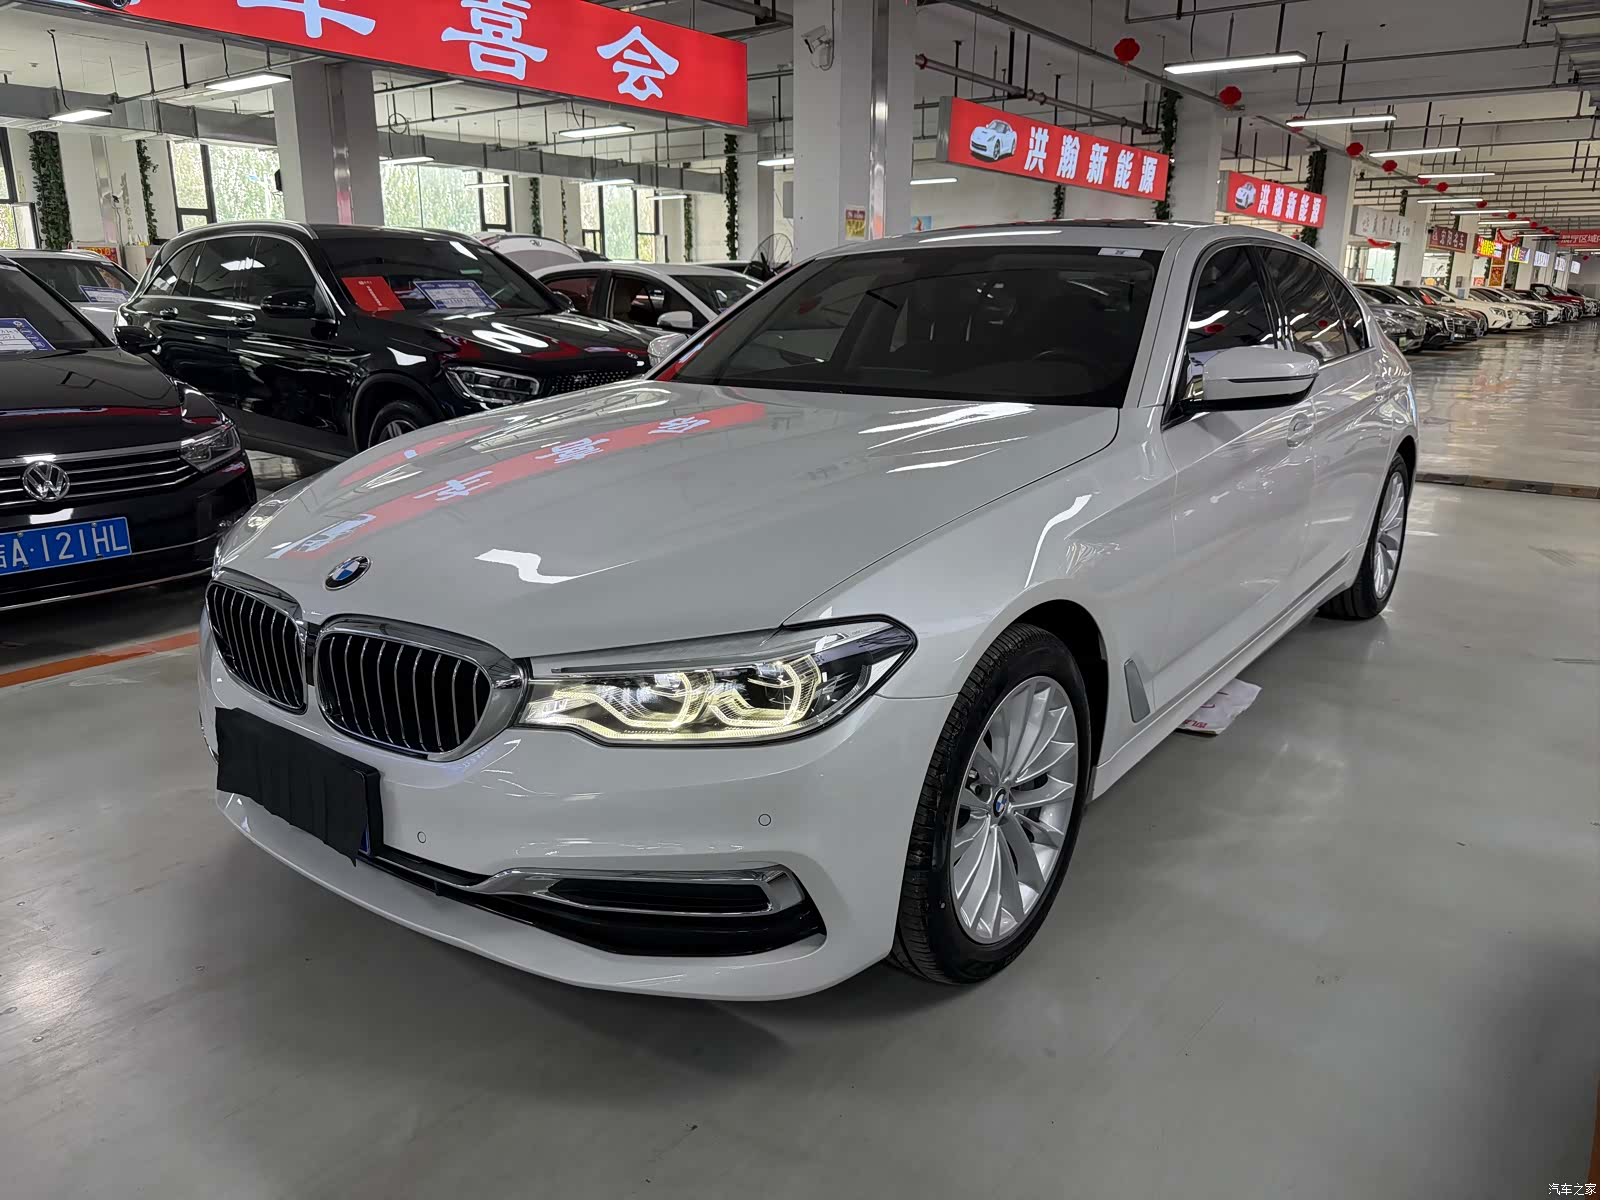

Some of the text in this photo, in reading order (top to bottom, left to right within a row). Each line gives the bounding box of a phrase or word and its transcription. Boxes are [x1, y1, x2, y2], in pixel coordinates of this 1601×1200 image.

[1024, 126, 1158, 193] 洪瀚新能源
[1257, 184, 1322, 224] 洪瀚新能源
